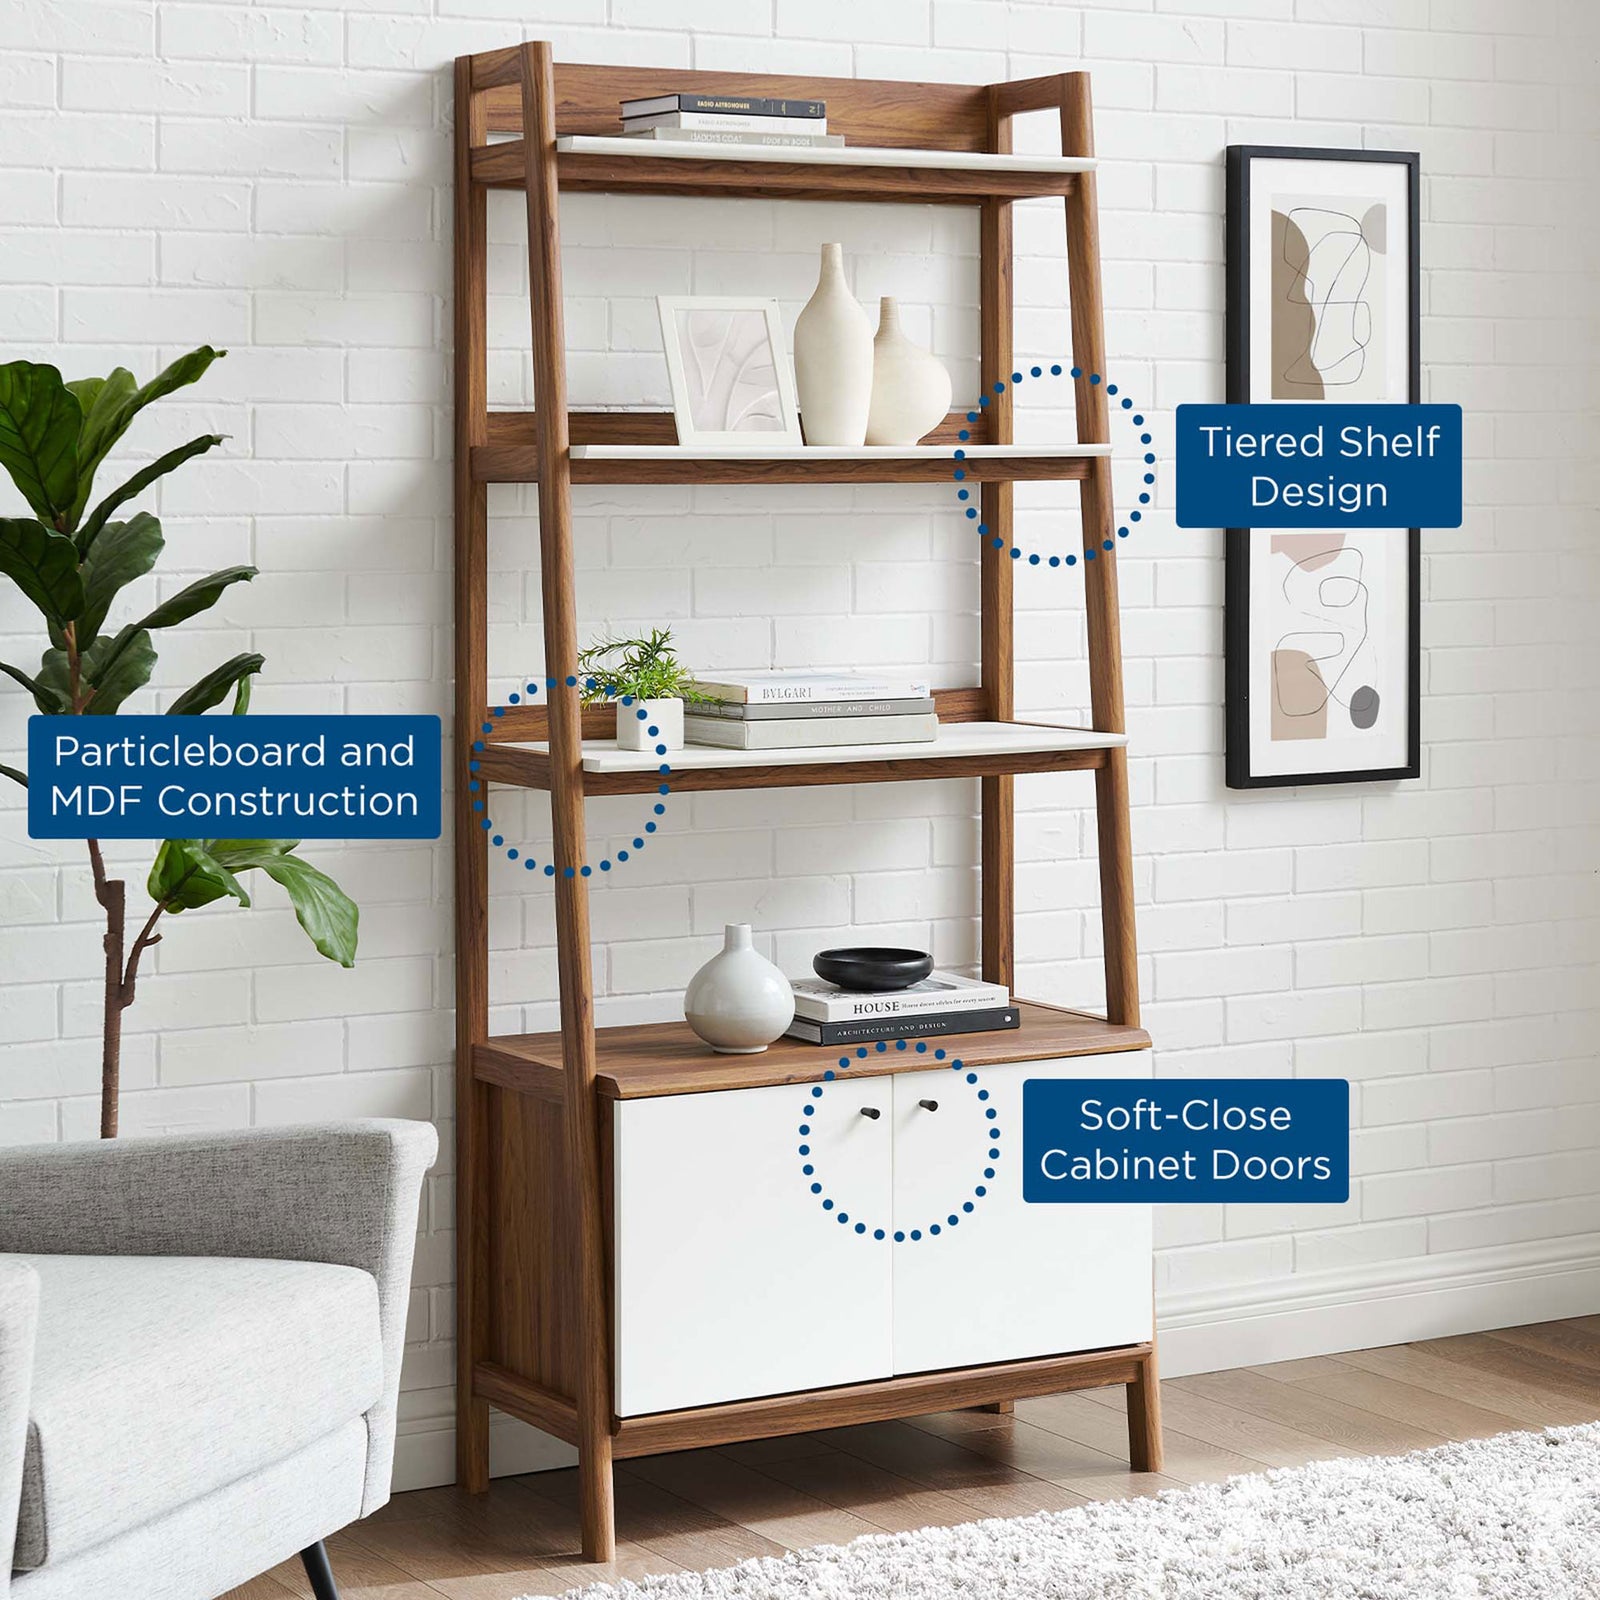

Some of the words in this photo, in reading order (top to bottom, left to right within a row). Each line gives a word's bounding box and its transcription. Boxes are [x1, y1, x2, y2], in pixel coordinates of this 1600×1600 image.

[763, 687, 811, 699] BVLGARI
[811, 706, 841, 714] MOTHER
[854, 1001, 900, 1014] HOUSE
[837, 1026, 896, 1037] ARCHITECTURE
[899, 1024, 916, 1032] AND
[919, 1022, 947, 1030] DESIGN
